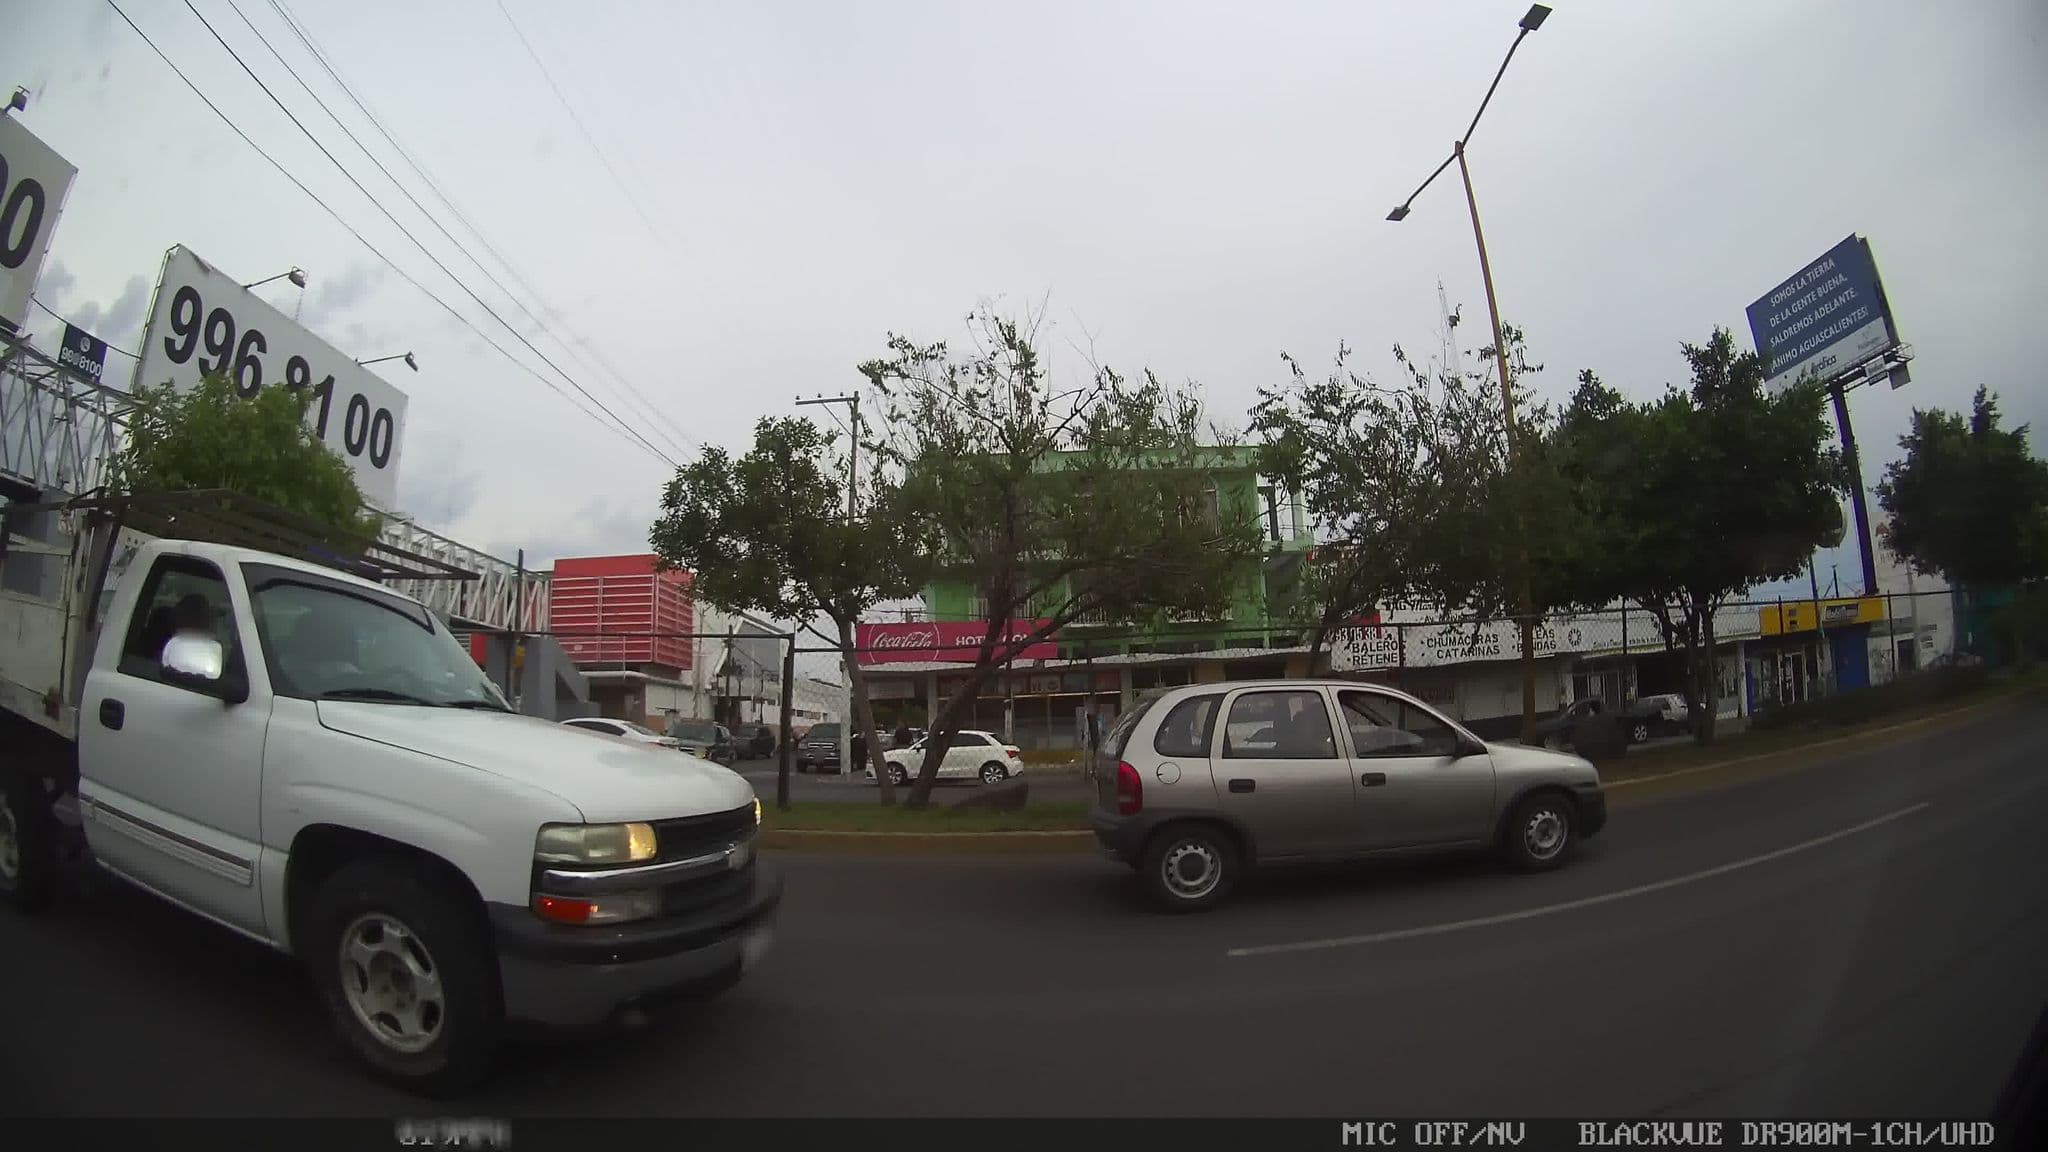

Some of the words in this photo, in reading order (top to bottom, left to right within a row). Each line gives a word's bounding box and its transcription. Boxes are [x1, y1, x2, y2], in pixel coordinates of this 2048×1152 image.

[0, 153, 45, 269] 0
[1769, 314, 1781, 328] DE
[1781, 308, 1792, 321] LA
[1791, 293, 1817, 314] GENTE
[1817, 272, 1848, 298] BUENA.
[1770, 284, 1796, 307] SOMOS
[1795, 278, 1808, 291] LA
[1806, 258, 1836, 283] TIERRA
[164, 285, 267, 399] 996
[1770, 314, 1813, 348] SALDREMOS
[1799, 306, 1869, 353] AGUASCALIENTES!
[1427, 633, 1499, 648] CHUMACRAS
[1436, 645, 1500, 659] CATARINAS
